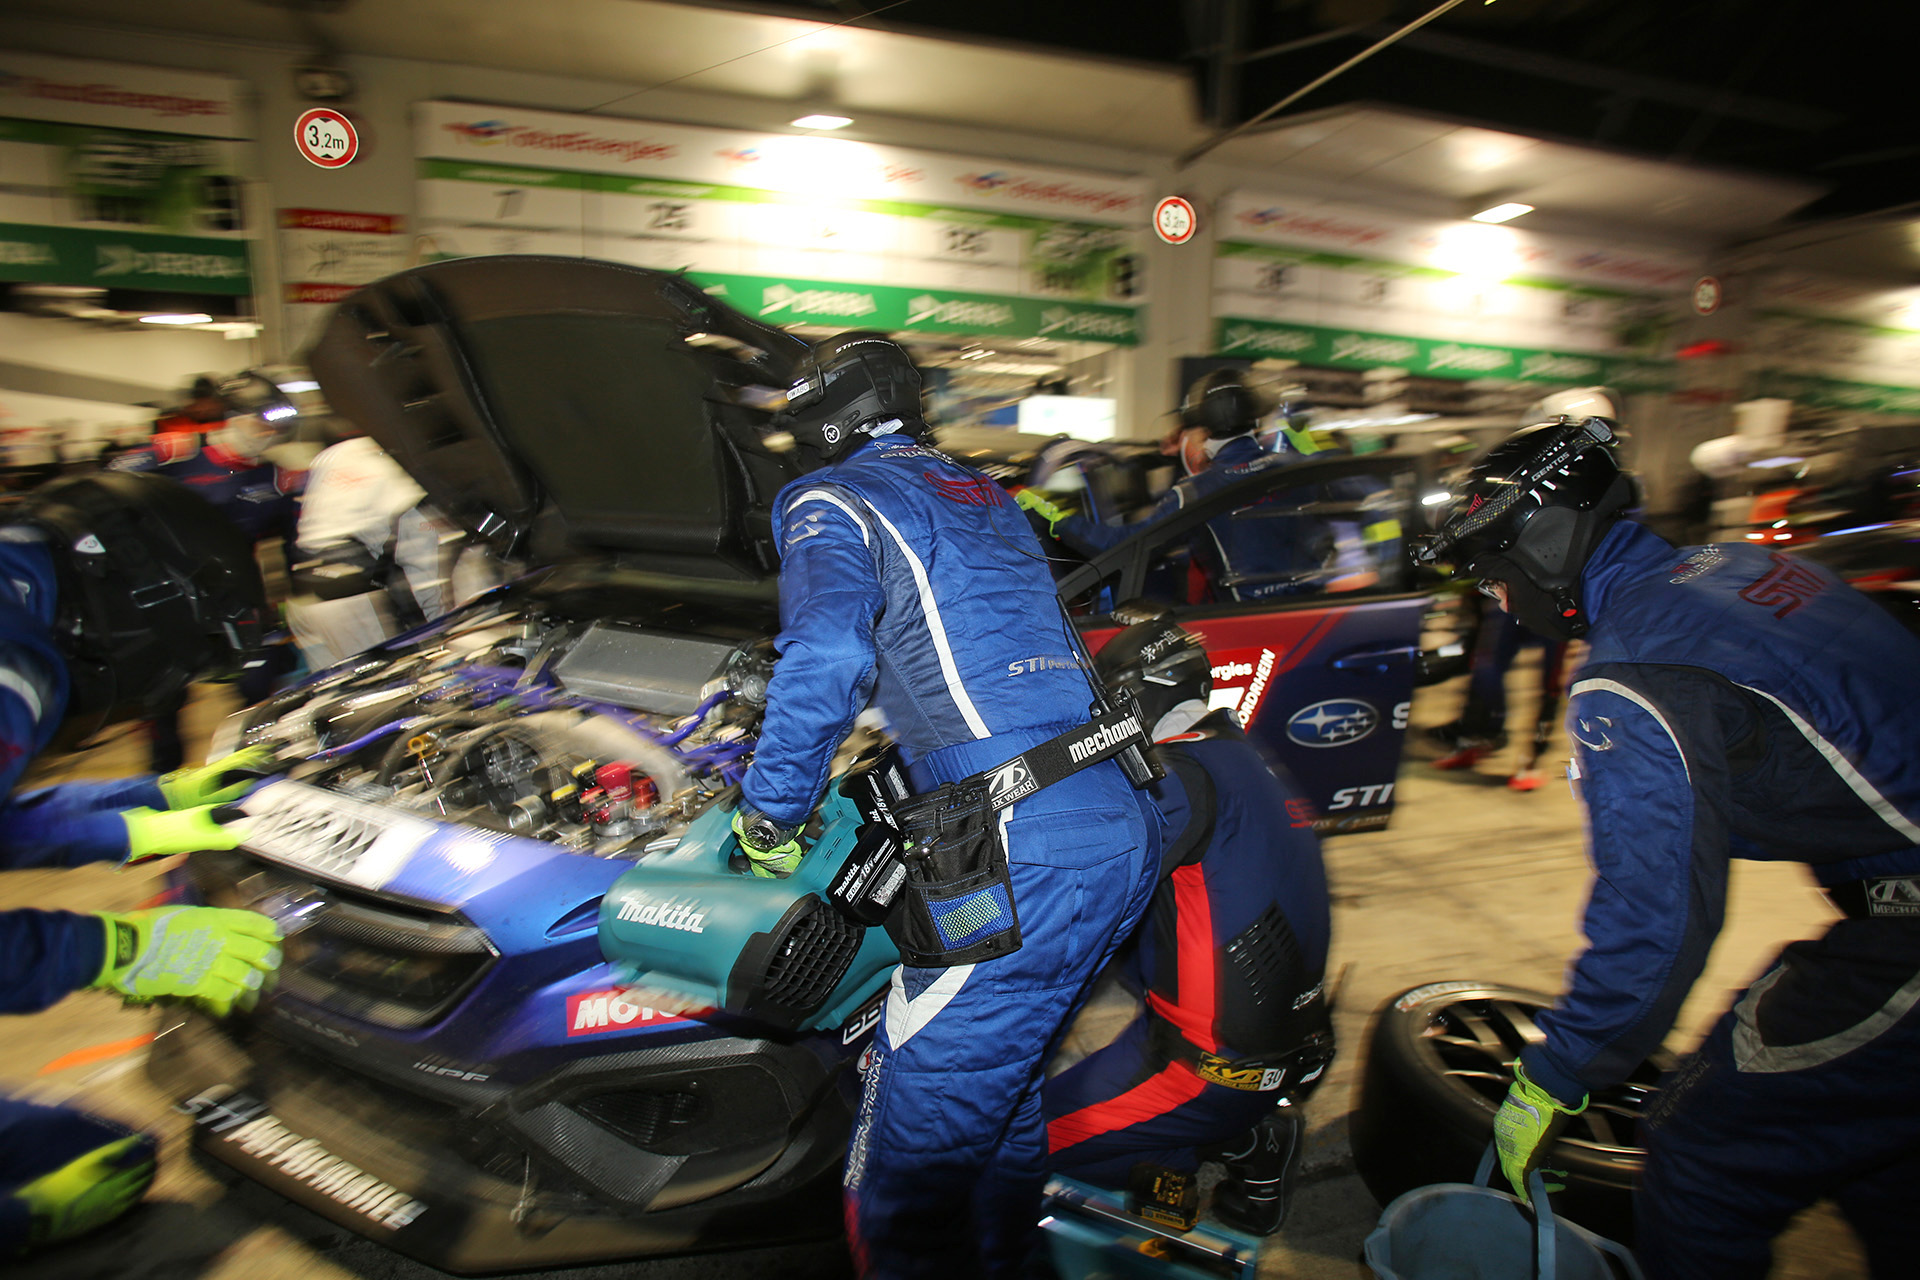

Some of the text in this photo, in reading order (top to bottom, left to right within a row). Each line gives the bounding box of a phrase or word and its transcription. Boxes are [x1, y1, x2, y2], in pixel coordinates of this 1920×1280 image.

[308, 125, 344, 150] 3.2m
[1531, 451, 1571, 482] GENTOS
[1007, 657, 1046, 677] STI
[1238, 648, 1276, 729] ORDRHEIN
[1068, 712, 1142, 764] mechanix
[1004, 779, 1035, 802] WEAR
[1328, 783, 1394, 810] STI
[850, 1053, 885, 1191] INTERNATIONAL
